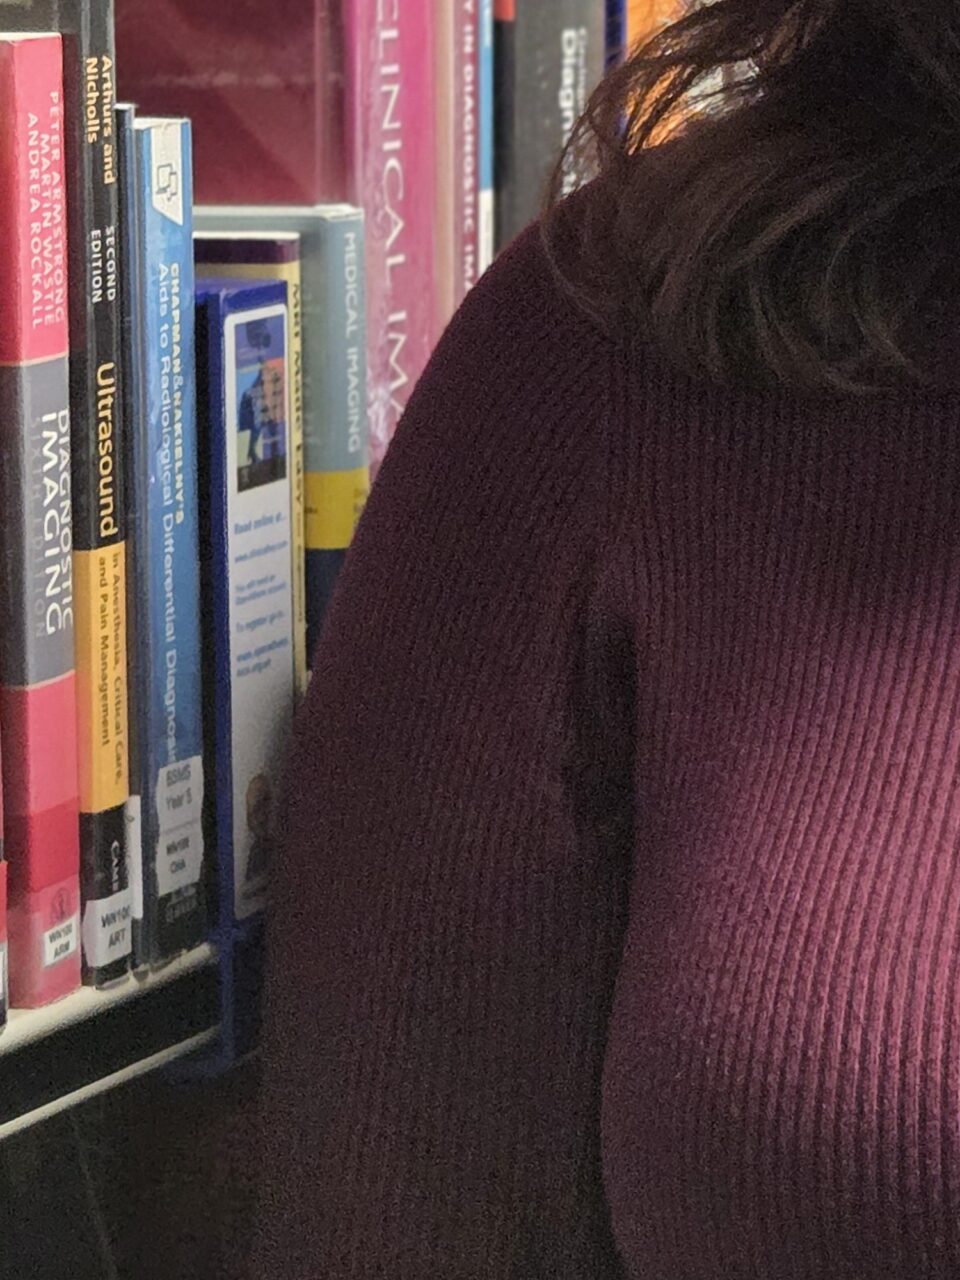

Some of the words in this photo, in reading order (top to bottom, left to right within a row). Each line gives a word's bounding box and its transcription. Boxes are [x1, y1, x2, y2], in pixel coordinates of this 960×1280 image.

[463, 25, 475, 53] IN
[50, 91, 60, 161] PETER
[86, 57, 100, 144] Nicholls
[102, 55, 114, 137] Arthurs
[26, 112, 41, 213] ANDREA
[41, 133, 53, 229] MARTIN
[103, 143, 116, 185] and
[463, 64, 476, 232] DIAGNOSTIC
[30, 222, 44, 328] ROCKALL
[42, 234, 57, 326] WASTIE
[51, 171, 65, 324] ARMSTRONG
[90, 229, 102, 304] EDITION
[105, 225, 116, 302] SECOND
[158, 263, 168, 315] Aids
[344, 232, 358, 337] MEDICAL
[160, 322, 168, 348] to
[160, 356, 174, 507] Radiological
[346, 346, 361, 454] IMAGING
[96, 362, 118, 538] Ultrasound
[41, 412, 62, 636] IMAGING
[57, 409, 74, 631] DIAGNOSTIC
[98, 556, 108, 587] and
[99, 596, 109, 633] Pain
[162, 511, 178, 643] Differential
[99, 637, 111, 748] Management
